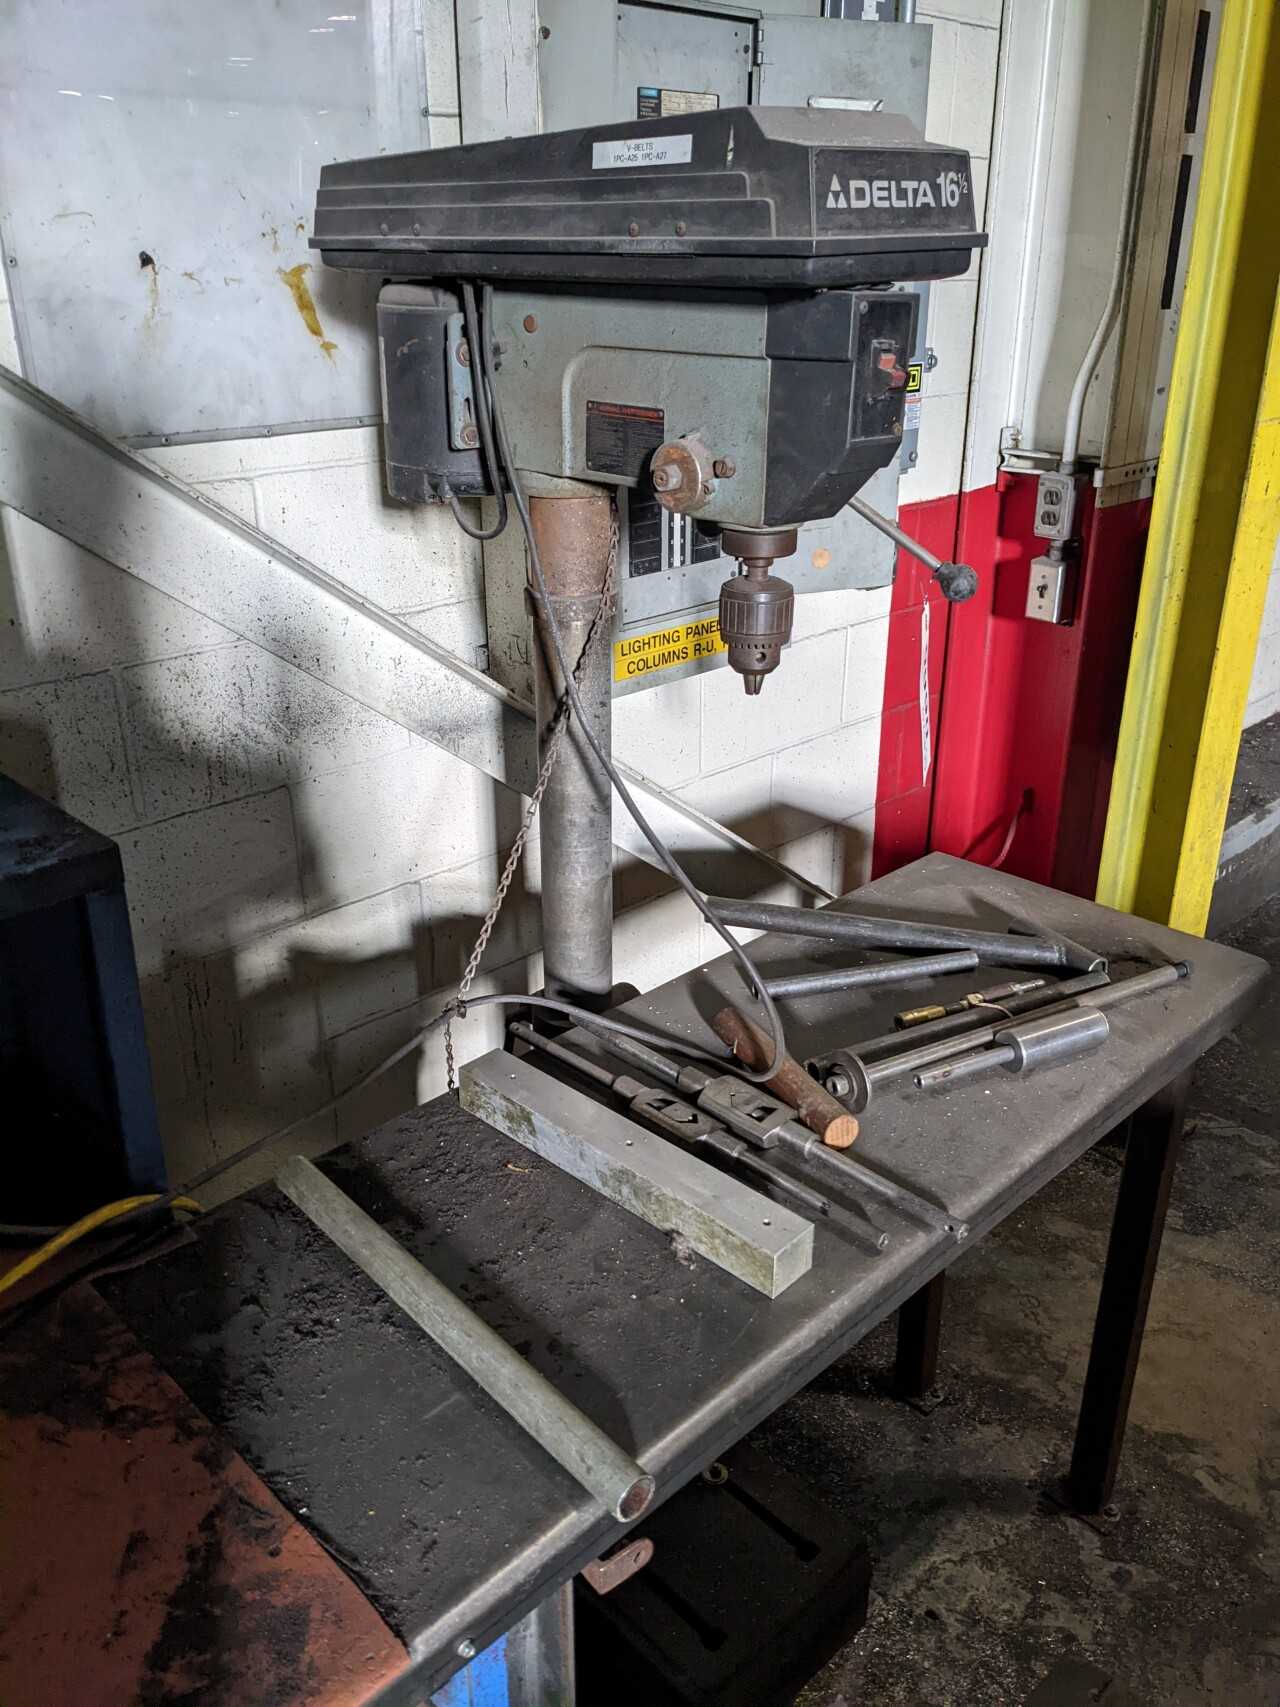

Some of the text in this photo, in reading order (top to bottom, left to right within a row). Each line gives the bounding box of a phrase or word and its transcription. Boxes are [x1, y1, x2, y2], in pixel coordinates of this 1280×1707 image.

[626, 143, 654, 152] V-BELTS
[849, 180, 936, 208] DELTA
[620, 630, 681, 657] LIGHTING
[626, 639, 717, 675] COLUMNS R-U,
